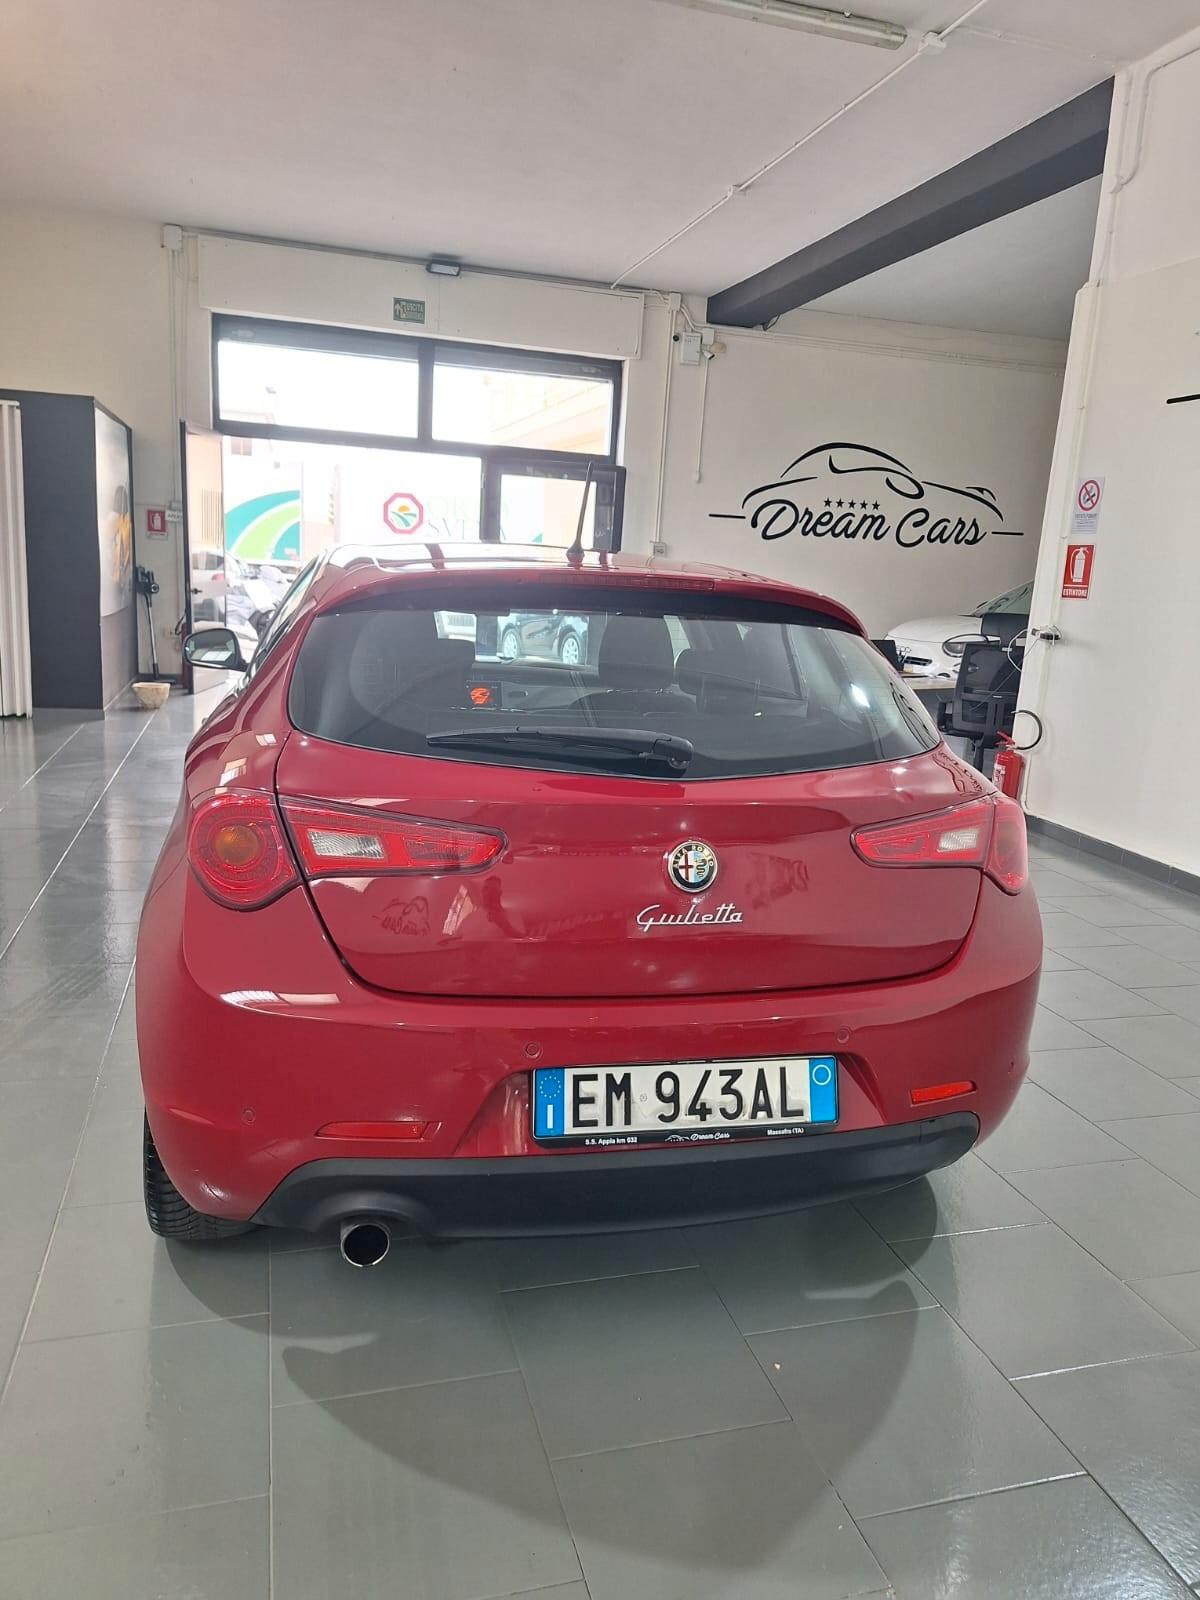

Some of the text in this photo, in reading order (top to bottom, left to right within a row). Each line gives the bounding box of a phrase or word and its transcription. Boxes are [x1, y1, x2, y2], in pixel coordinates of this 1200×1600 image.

[751, 499, 987, 548] Dream Cars
[636, 903, 743, 932] Giulietta
[572, 1072, 632, 1129] EM
[655, 1066, 804, 1123] 943AL
[598, 1137, 616, 1146] Appia
